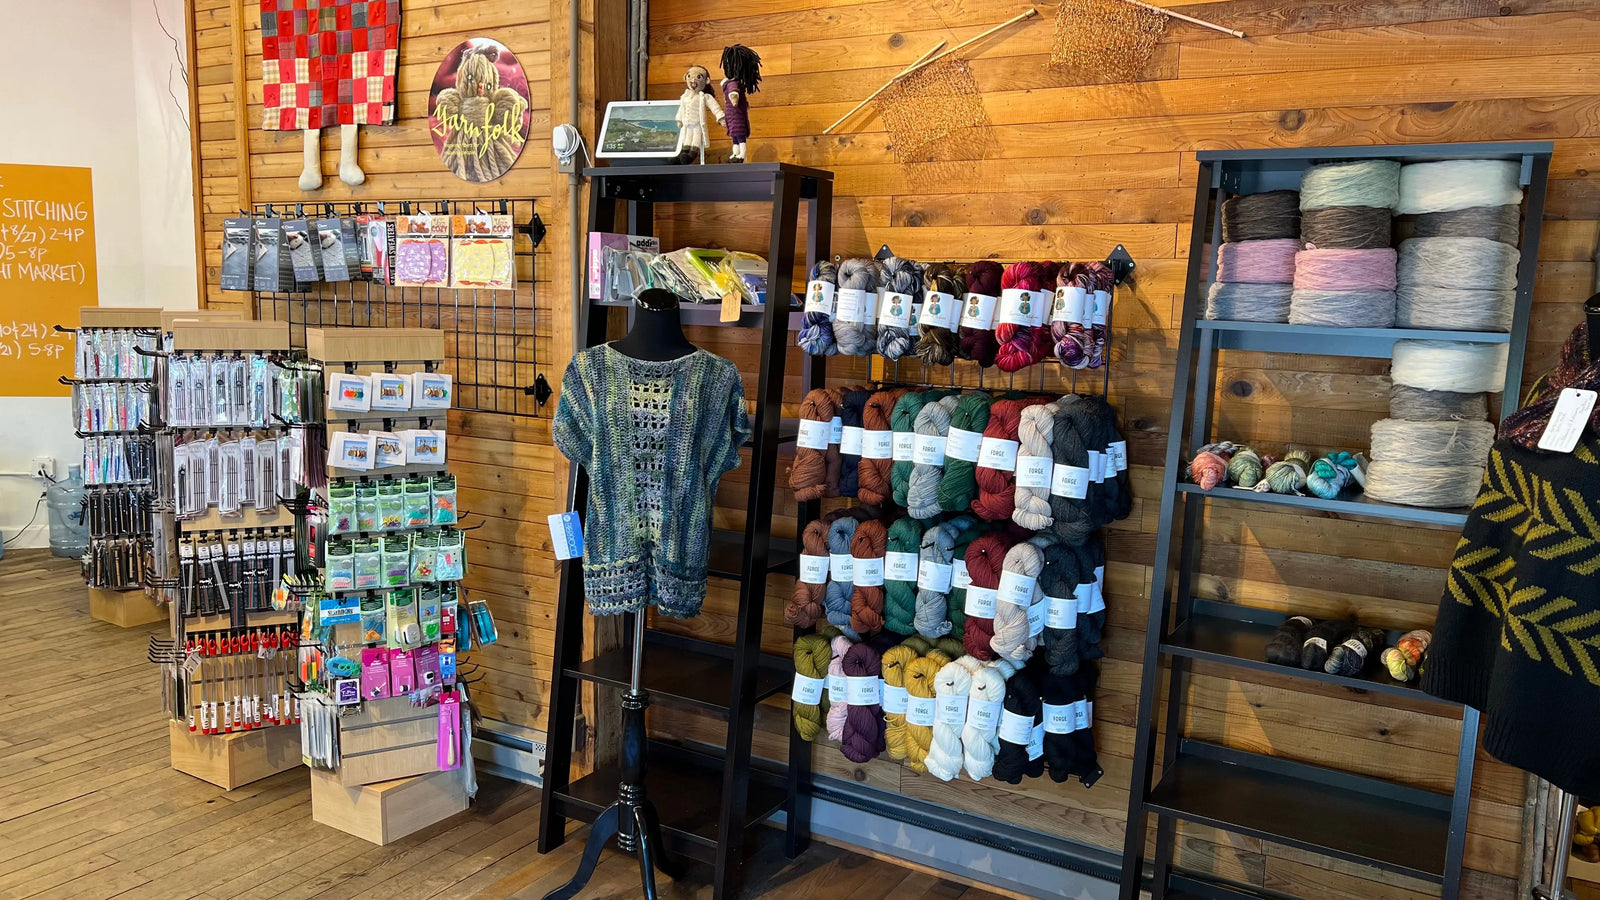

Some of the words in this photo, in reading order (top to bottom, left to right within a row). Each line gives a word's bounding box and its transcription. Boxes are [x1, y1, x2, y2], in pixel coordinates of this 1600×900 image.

[2, 198, 88, 222] STITCHING
[431, 225, 447, 233] COZY
[387, 223, 396, 255] SWEATERS
[1062, 477, 1077, 485] FORGE
[1014, 585, 1029, 594] FORGE
[978, 598, 992, 606] FORGE
[977, 710, 991, 718] FORGE
